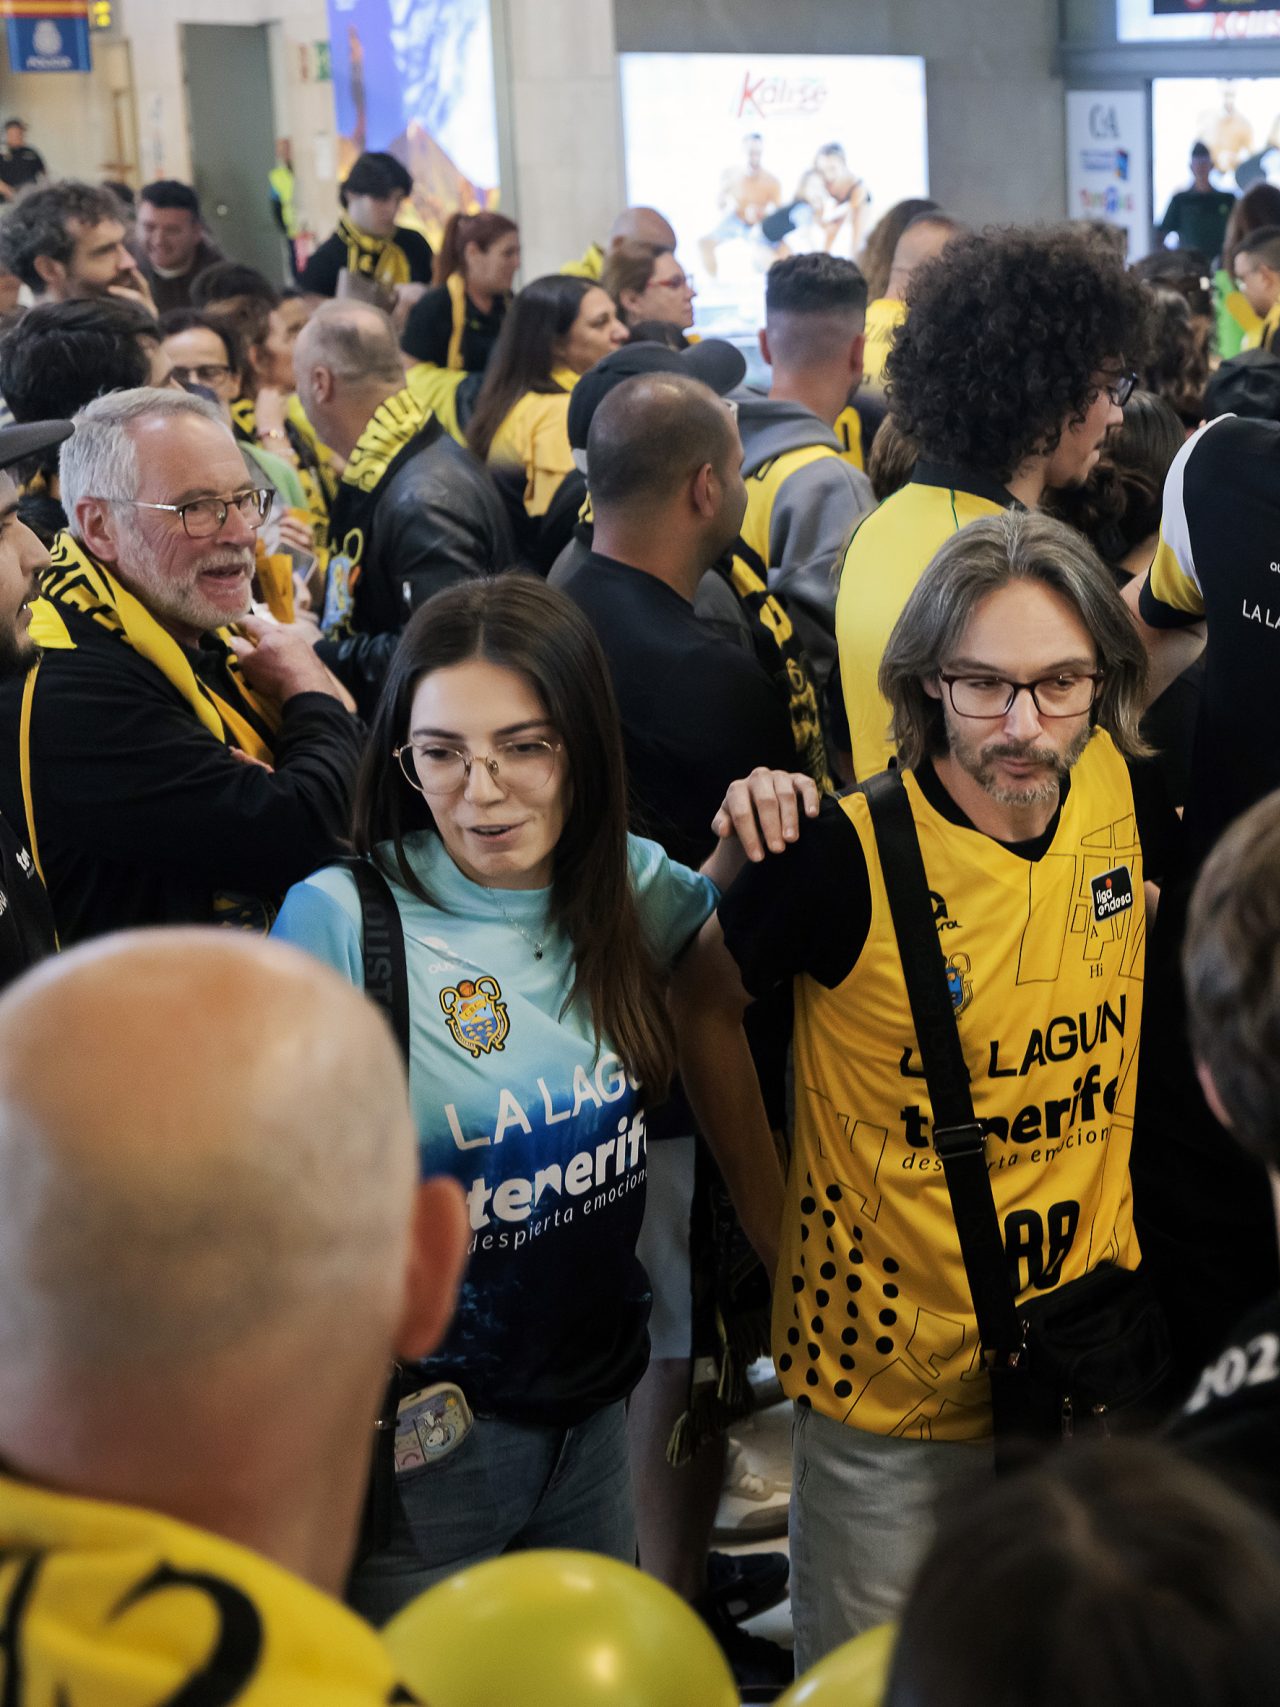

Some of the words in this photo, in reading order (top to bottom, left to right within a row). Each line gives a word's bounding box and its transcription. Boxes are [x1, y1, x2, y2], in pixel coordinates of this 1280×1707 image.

[1242, 599, 1262, 624] LA
[988, 993, 1126, 1079] LAGUN
[444, 1089, 532, 1152] LA
[466, 1109, 648, 1231] tenerif
[583, 1168, 648, 1216] emocion
